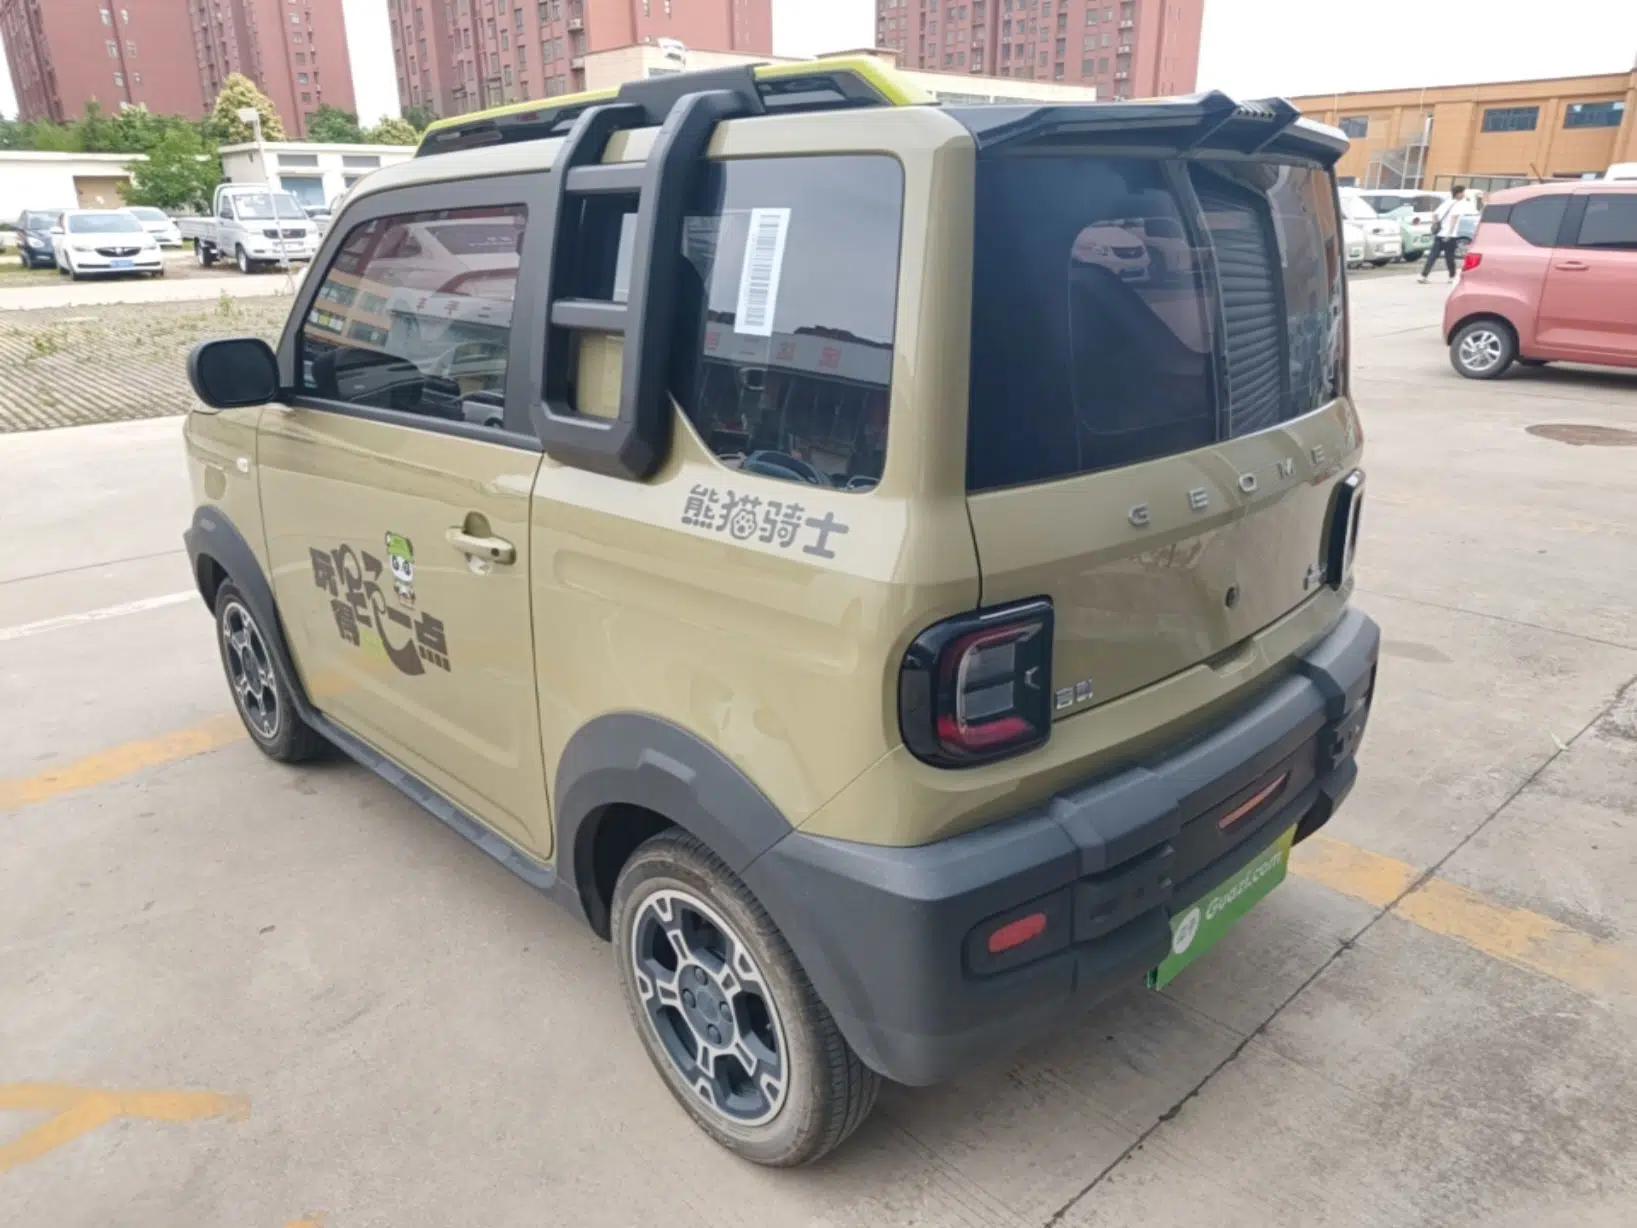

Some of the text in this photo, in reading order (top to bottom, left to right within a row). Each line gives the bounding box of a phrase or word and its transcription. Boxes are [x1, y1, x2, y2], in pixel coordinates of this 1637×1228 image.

[681, 484, 849, 559] 熊猫骑士
[1128, 444, 1328, 527] GEOME
